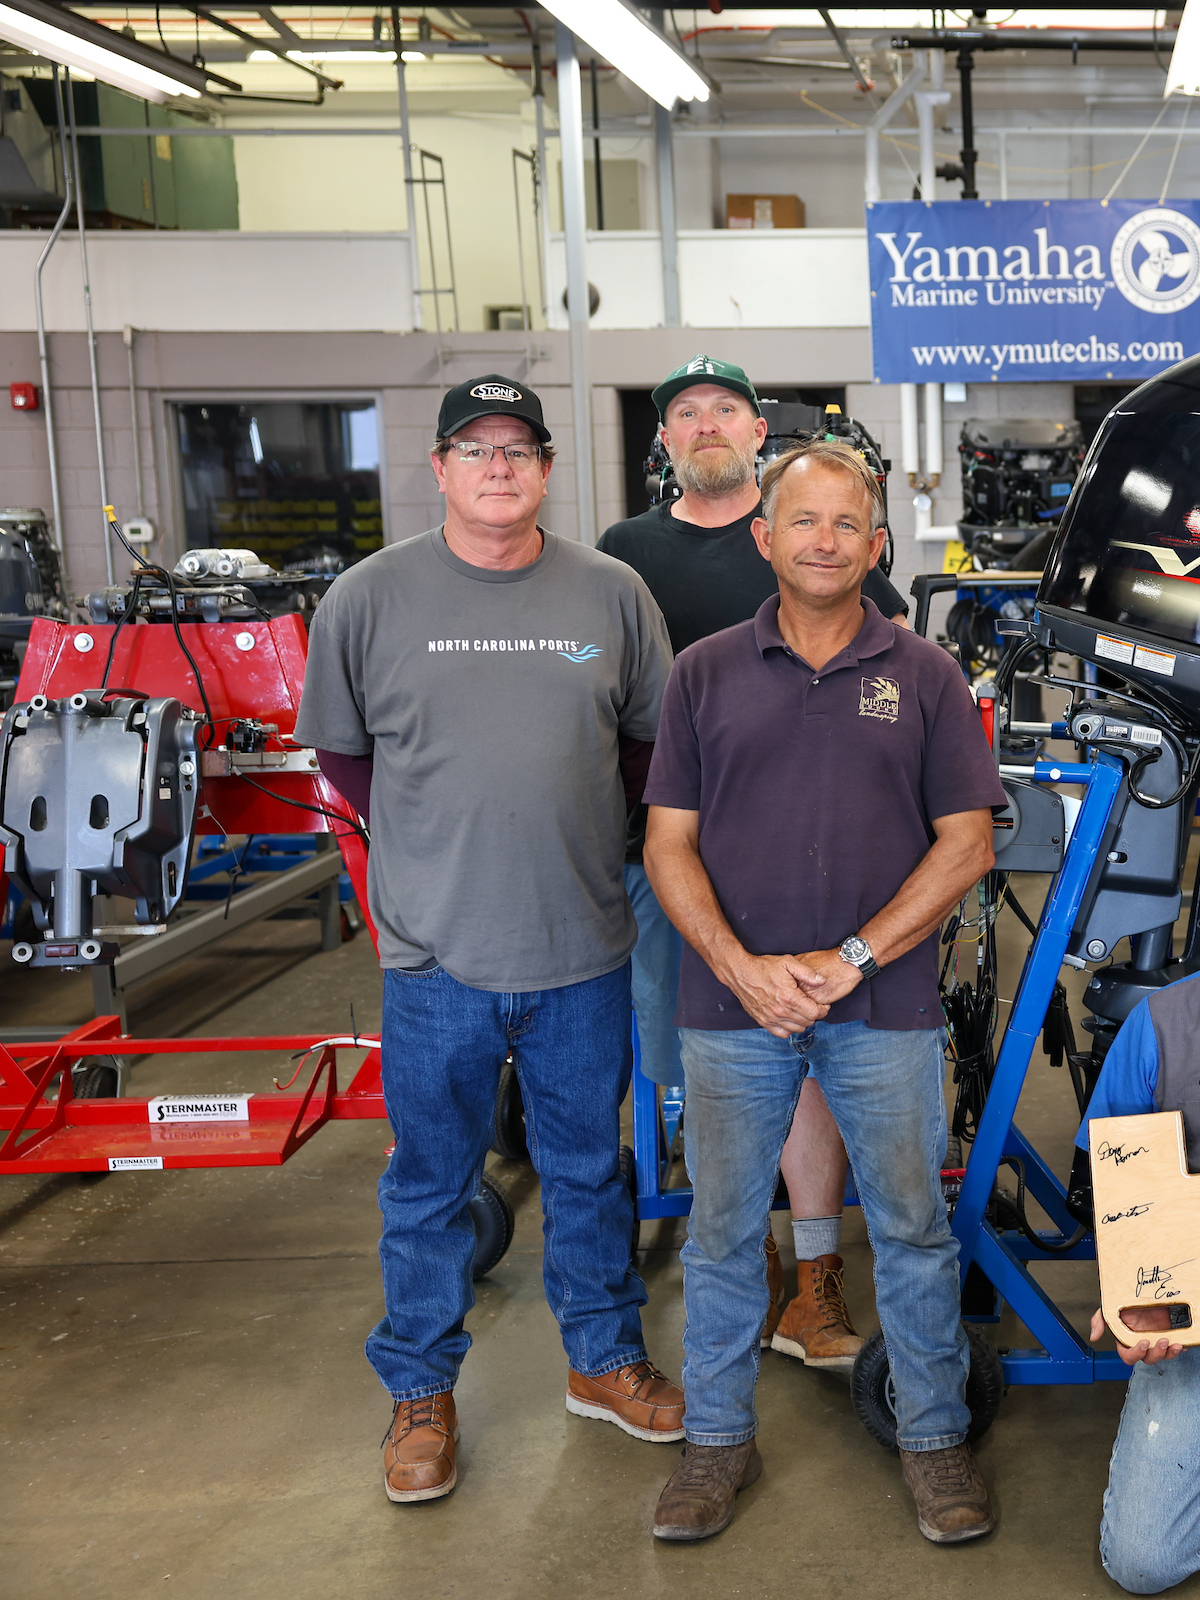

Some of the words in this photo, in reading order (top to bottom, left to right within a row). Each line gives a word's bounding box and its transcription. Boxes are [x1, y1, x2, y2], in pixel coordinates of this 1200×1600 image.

[876, 227, 1105, 282] Yamaha
[891, 285, 978, 307] Marine
[986, 281, 1104, 310] University
[911, 335, 1185, 370] www.ymutechs.com
[479, 386, 515, 397] STONE
[428, 640, 469, 652] NORTH
[473, 640, 536, 651] CAROLINA
[539, 640, 580, 652] PORTS
[862, 697, 897, 709] MIDDLE
[157, 1103, 238, 1121] STERNMASTER
